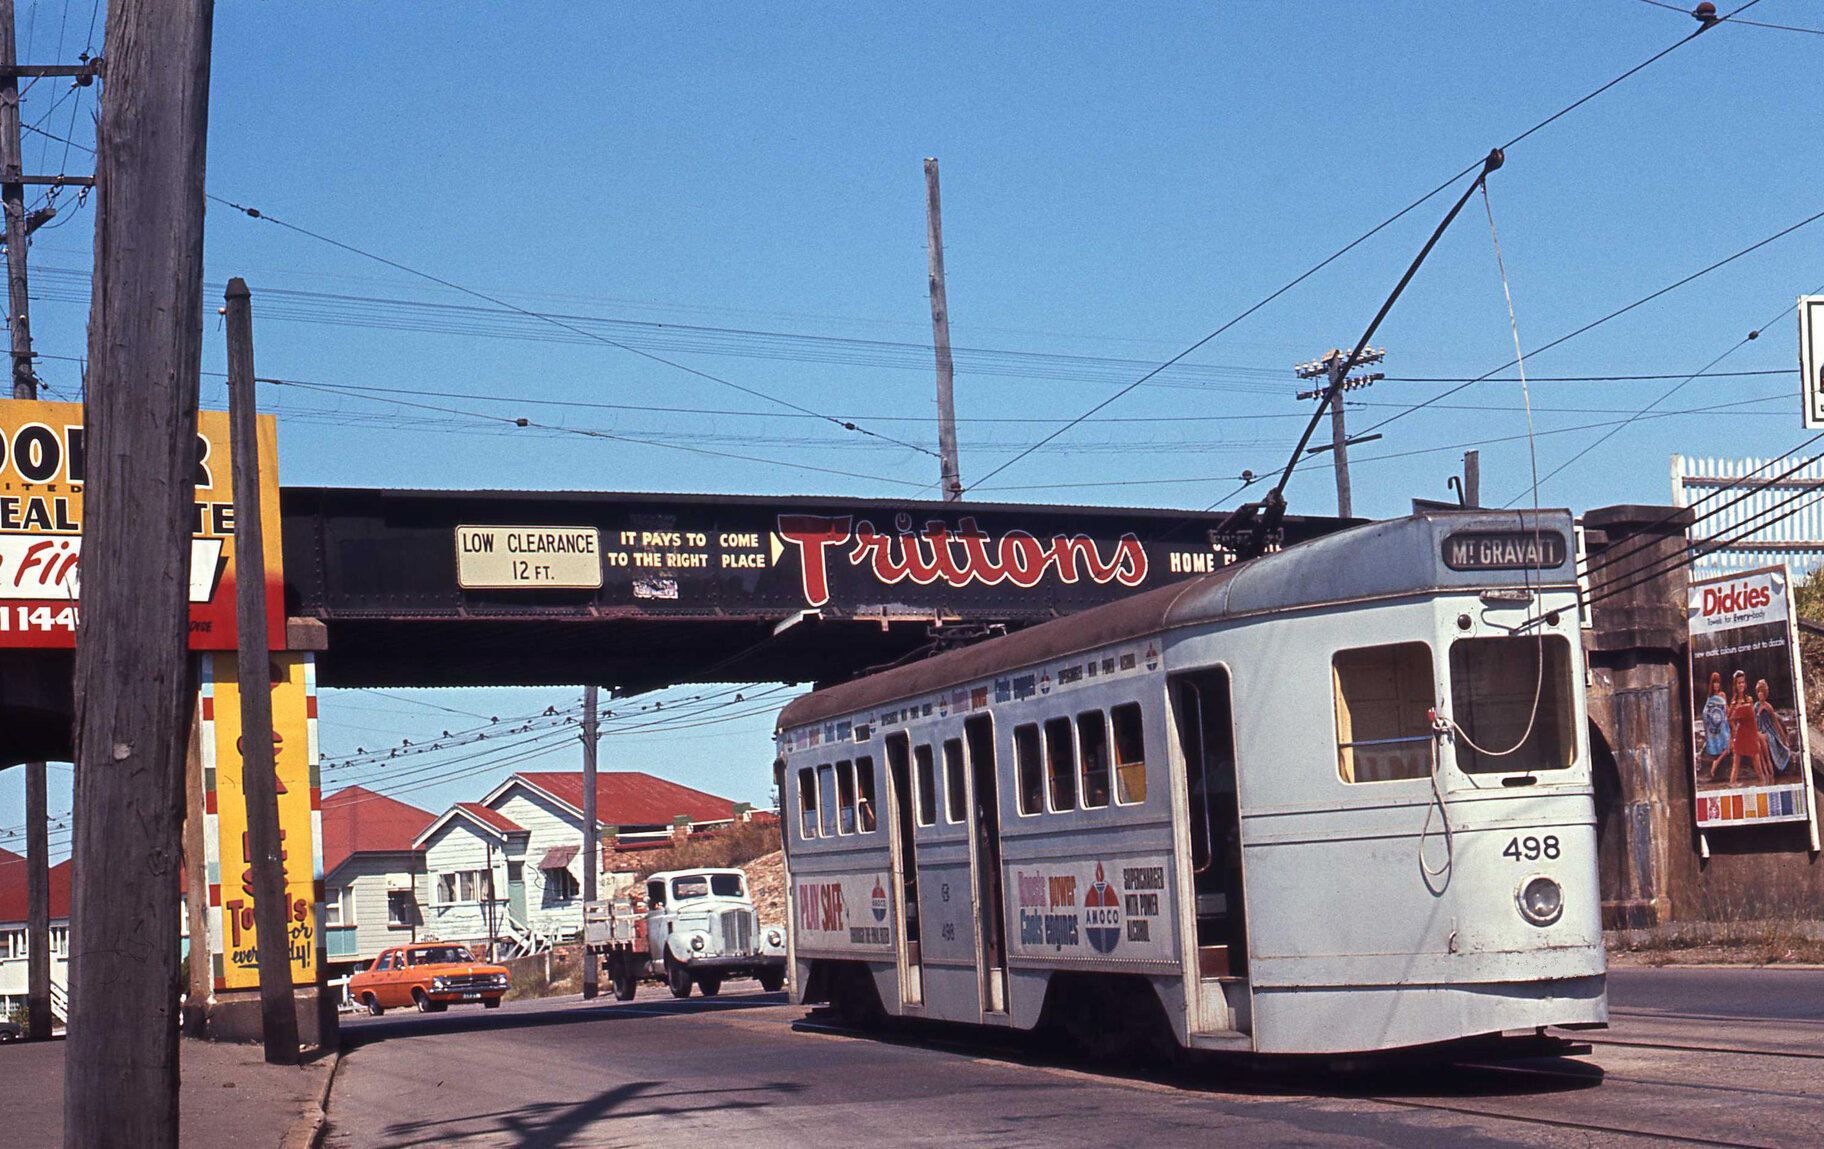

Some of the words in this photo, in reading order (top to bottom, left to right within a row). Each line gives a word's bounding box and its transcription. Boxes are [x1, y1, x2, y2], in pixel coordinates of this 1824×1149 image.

[463, 533, 494, 553] LOW
[507, 533, 595, 554] CLEARANCE
[620, 531, 637, 546] IT
[642, 532, 681, 547] PAYS
[686, 533, 706, 548] TO
[719, 533, 759, 547] COME
[608, 552, 629, 567] TO
[633, 553, 662, 567] THE
[666, 553, 708, 568] RIGHT
[721, 554, 766, 568] PLACE
[1480, 539, 1556, 565] GRAVATT
[513, 560, 529, 580] 12
[535, 566, 554, 580] FT.
[1170, 552, 1215, 573] HOME
[1703, 582, 1770, 616] Dickies
[1724, 615, 1732, 624] for
[1738, 644, 1751, 652] come
[1752, 642, 1760, 650] out
[1503, 835, 1560, 862] 498
[800, 883, 820, 931] PLAY
[820, 882, 844, 932] SAFE
[1086, 909, 1119, 925] AMOCO
